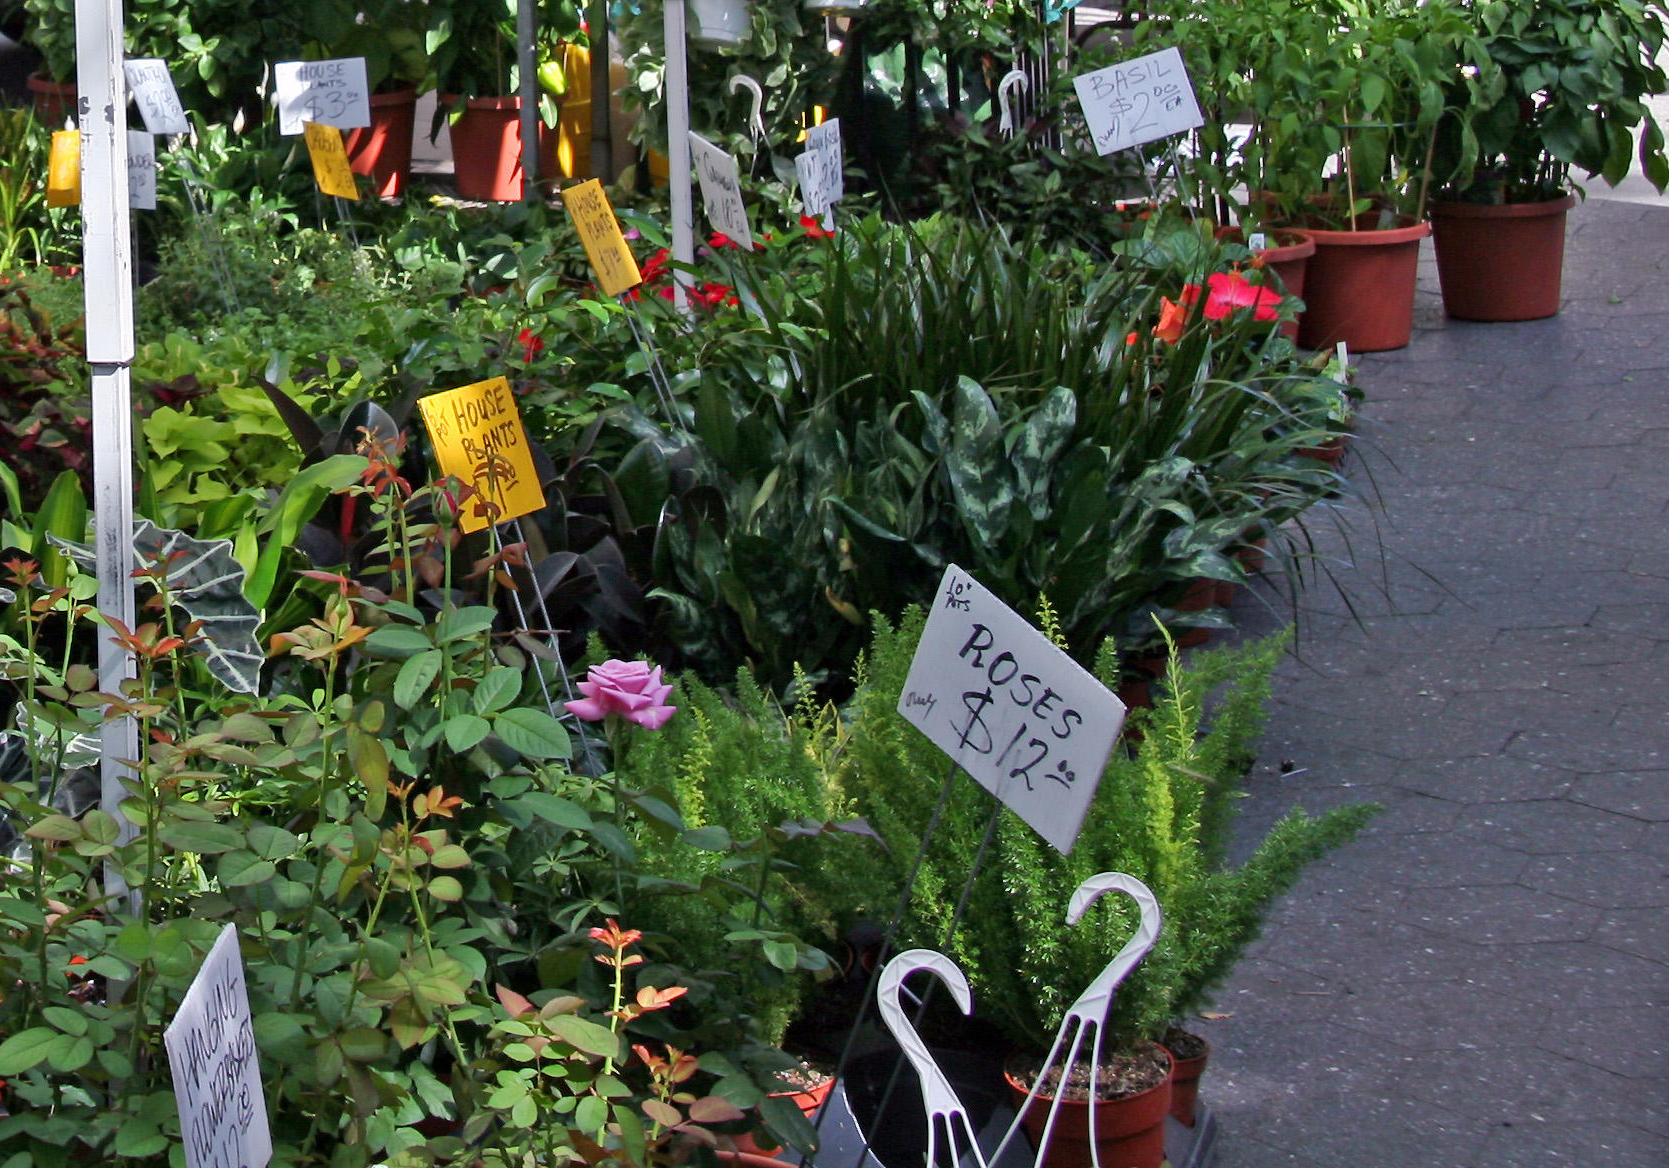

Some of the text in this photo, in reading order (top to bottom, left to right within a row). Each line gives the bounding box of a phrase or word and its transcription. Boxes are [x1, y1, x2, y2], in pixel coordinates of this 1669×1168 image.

[298, 62, 346, 81] HOUSE
[1090, 59, 1171, 101] BASIL
[451, 384, 506, 435] HOUSE
[461, 420, 518, 465] PLANTS
[958, 623, 1083, 740] ROSES
[178, 957, 239, 1108] HANGING
